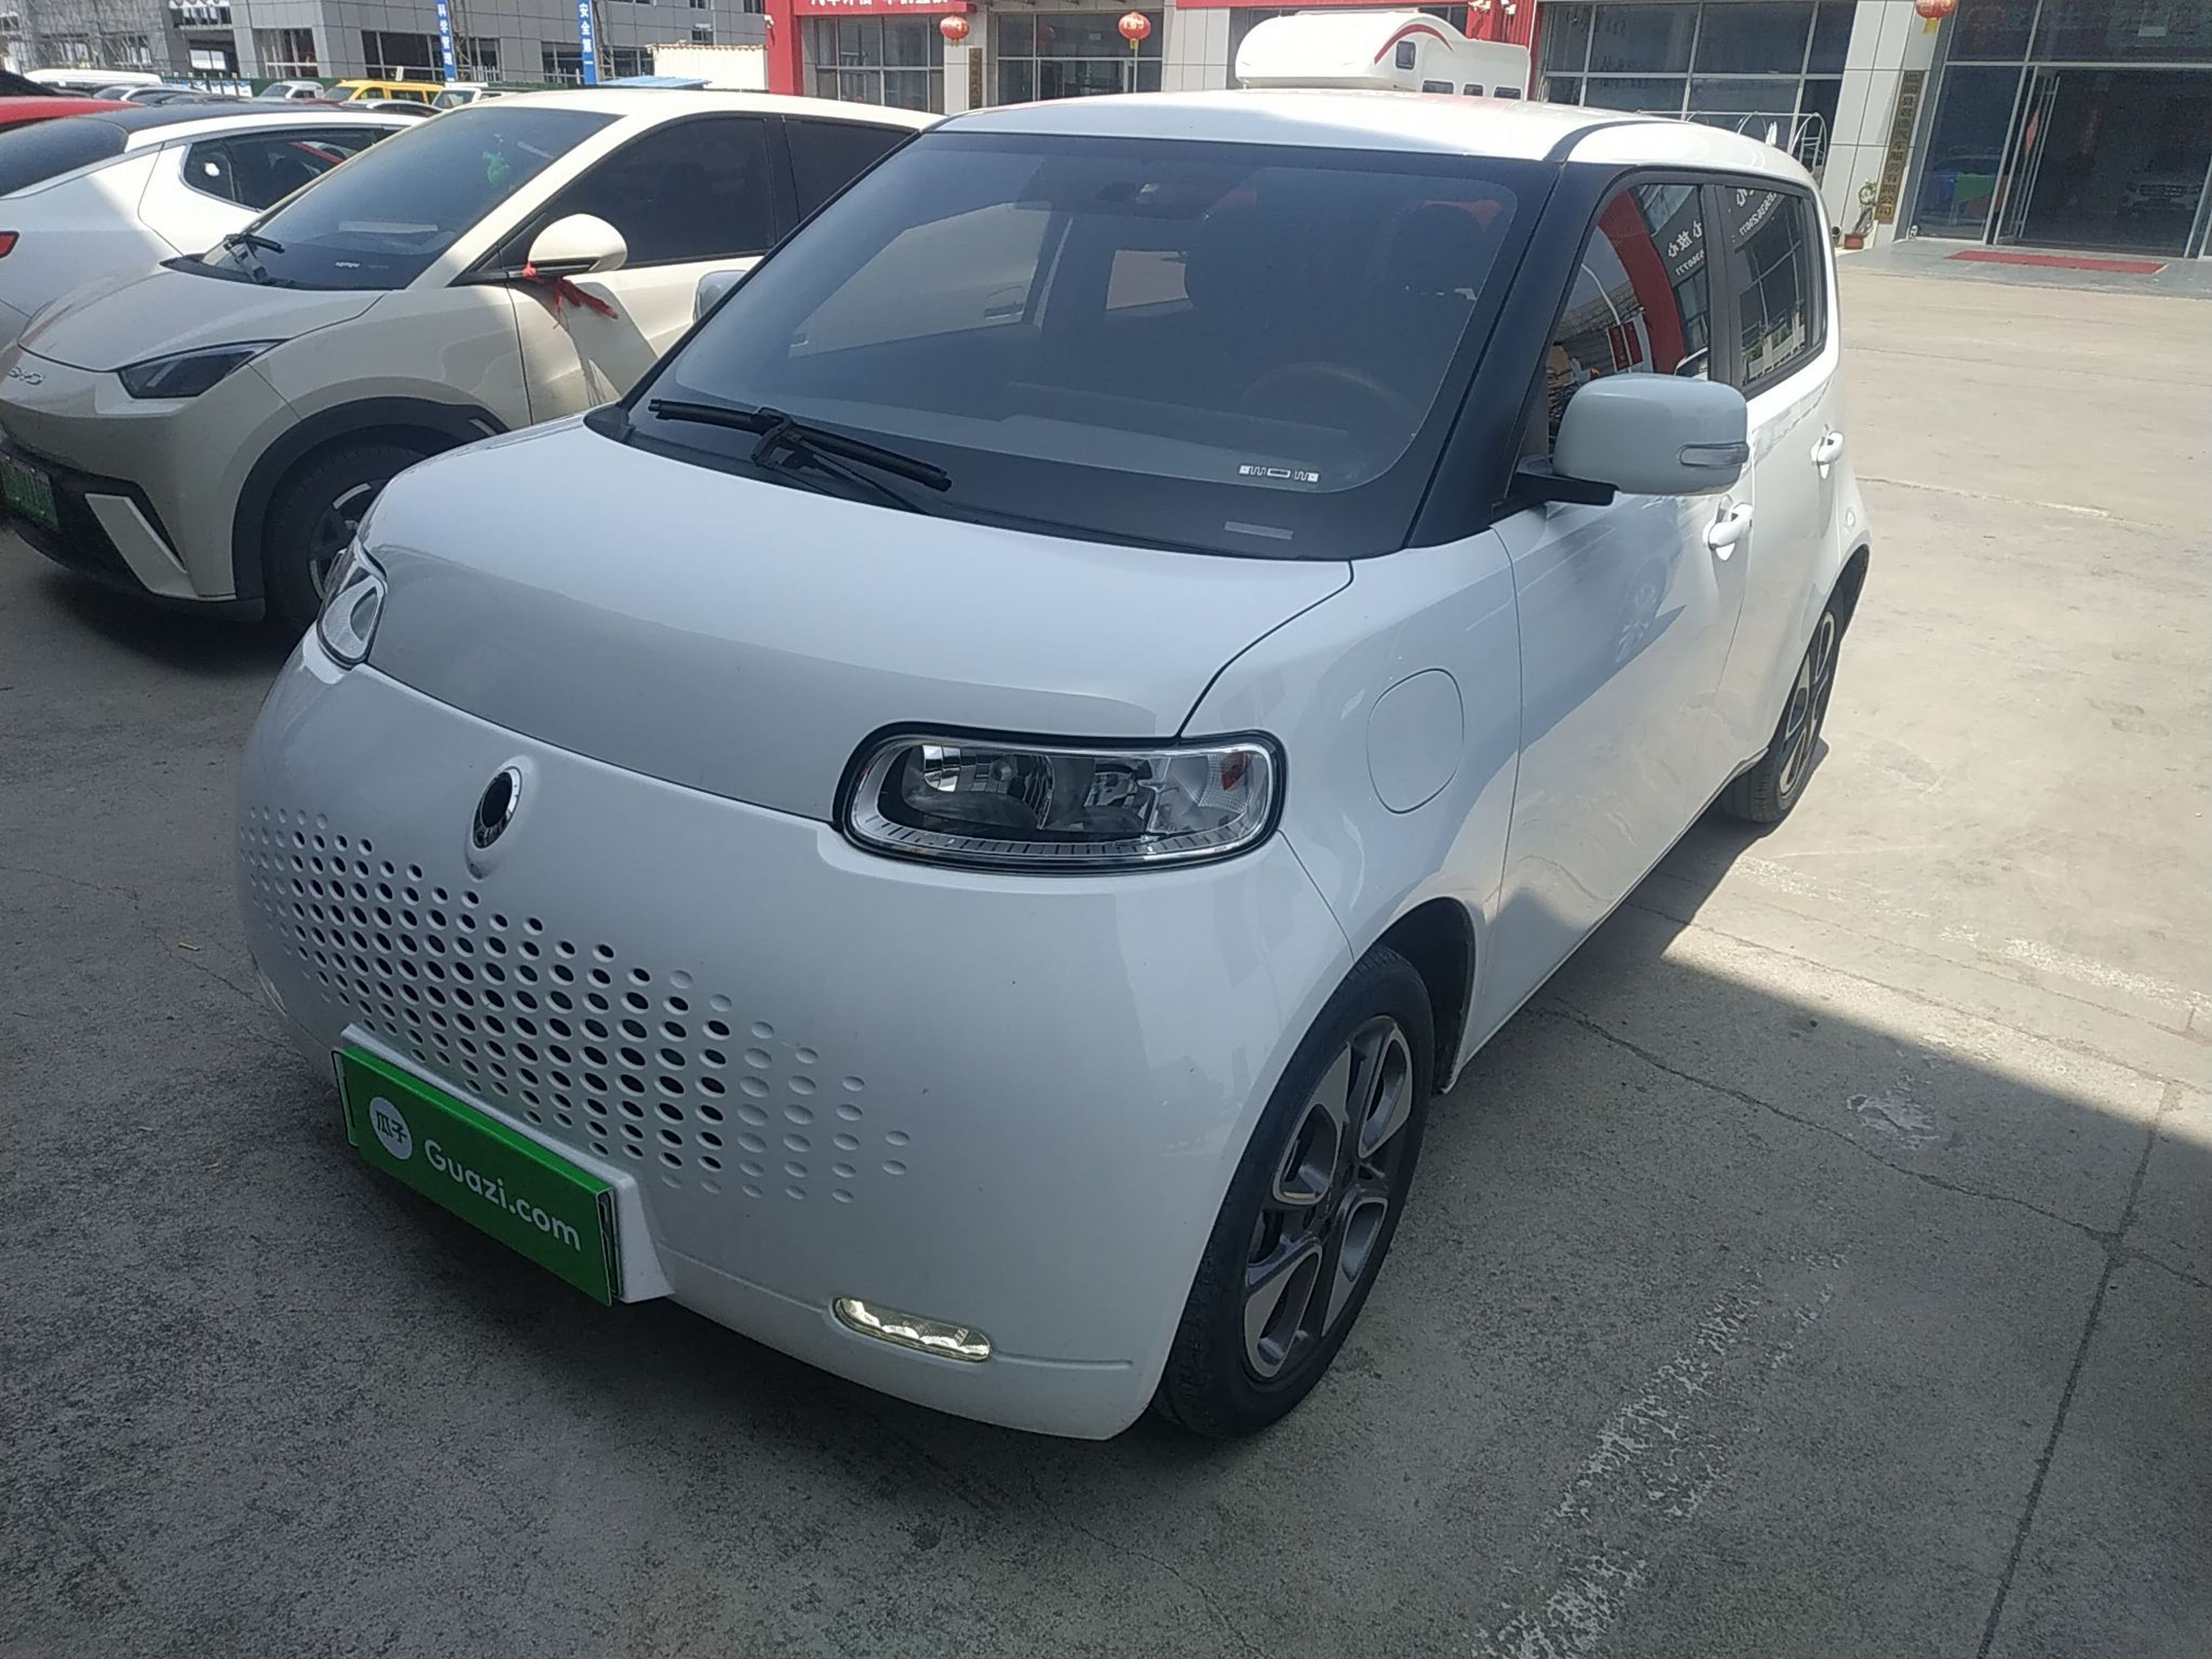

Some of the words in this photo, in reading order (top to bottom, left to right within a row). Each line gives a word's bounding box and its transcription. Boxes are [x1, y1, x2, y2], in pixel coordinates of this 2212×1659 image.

[578, 2, 594, 65] 安全第一
[376, 1110, 407, 1143] 瓜子
[425, 1139, 581, 1251] Guazi.com
